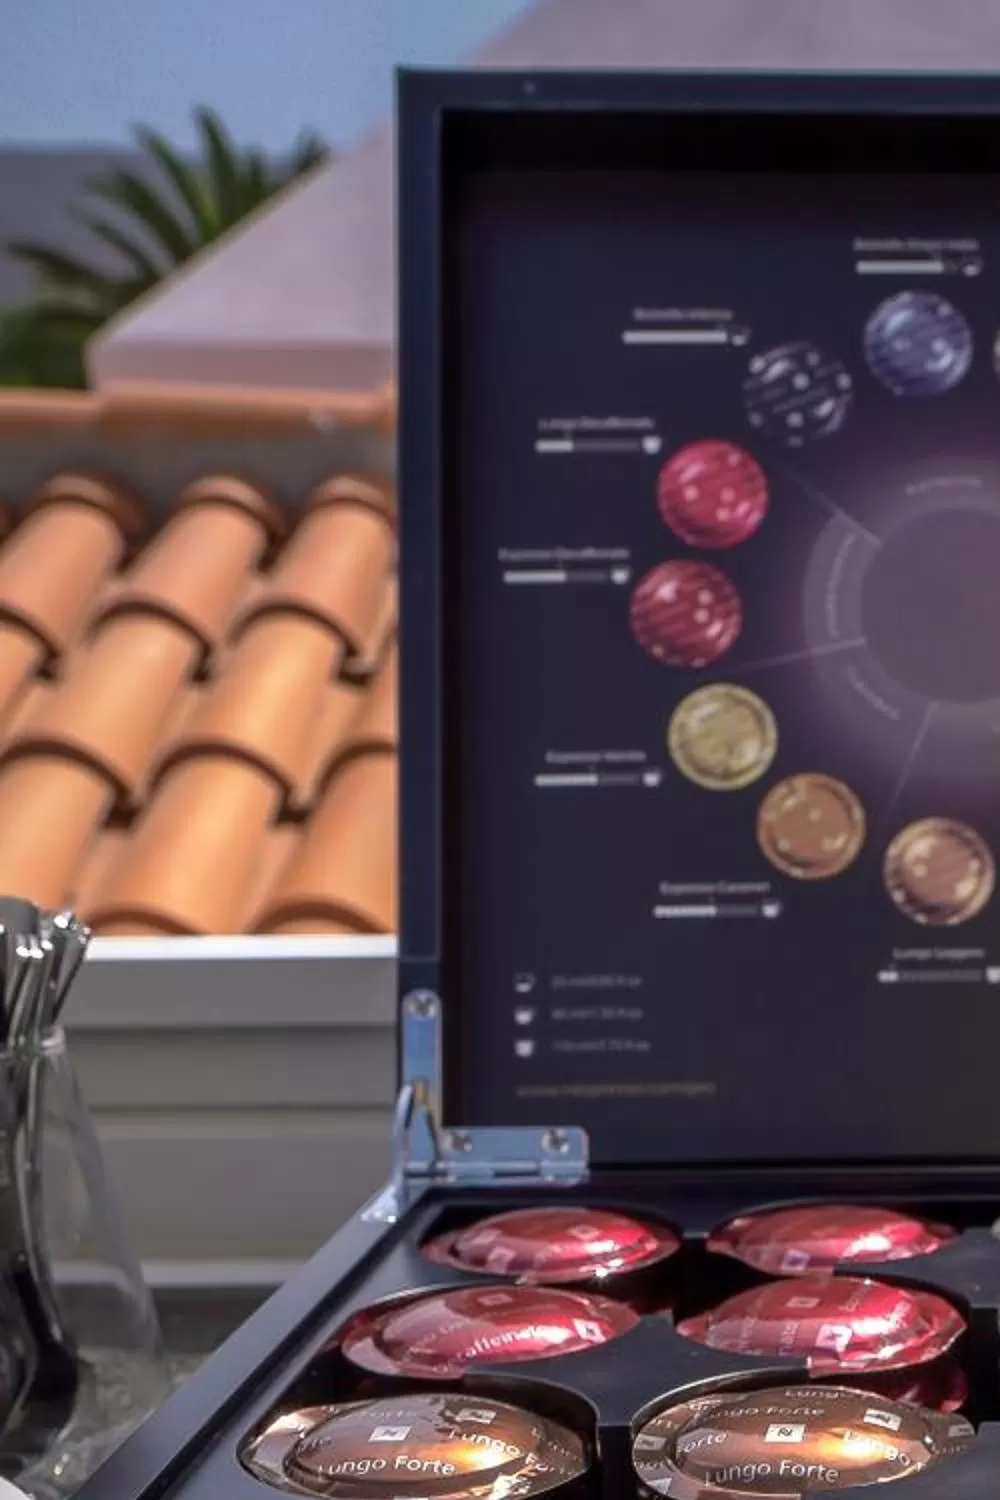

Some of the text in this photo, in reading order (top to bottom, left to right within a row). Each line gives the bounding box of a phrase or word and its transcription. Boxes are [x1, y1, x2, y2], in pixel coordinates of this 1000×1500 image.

[317, 1455, 457, 1478] Lungo Forte
[704, 1459, 841, 1488] Lungo Forte
